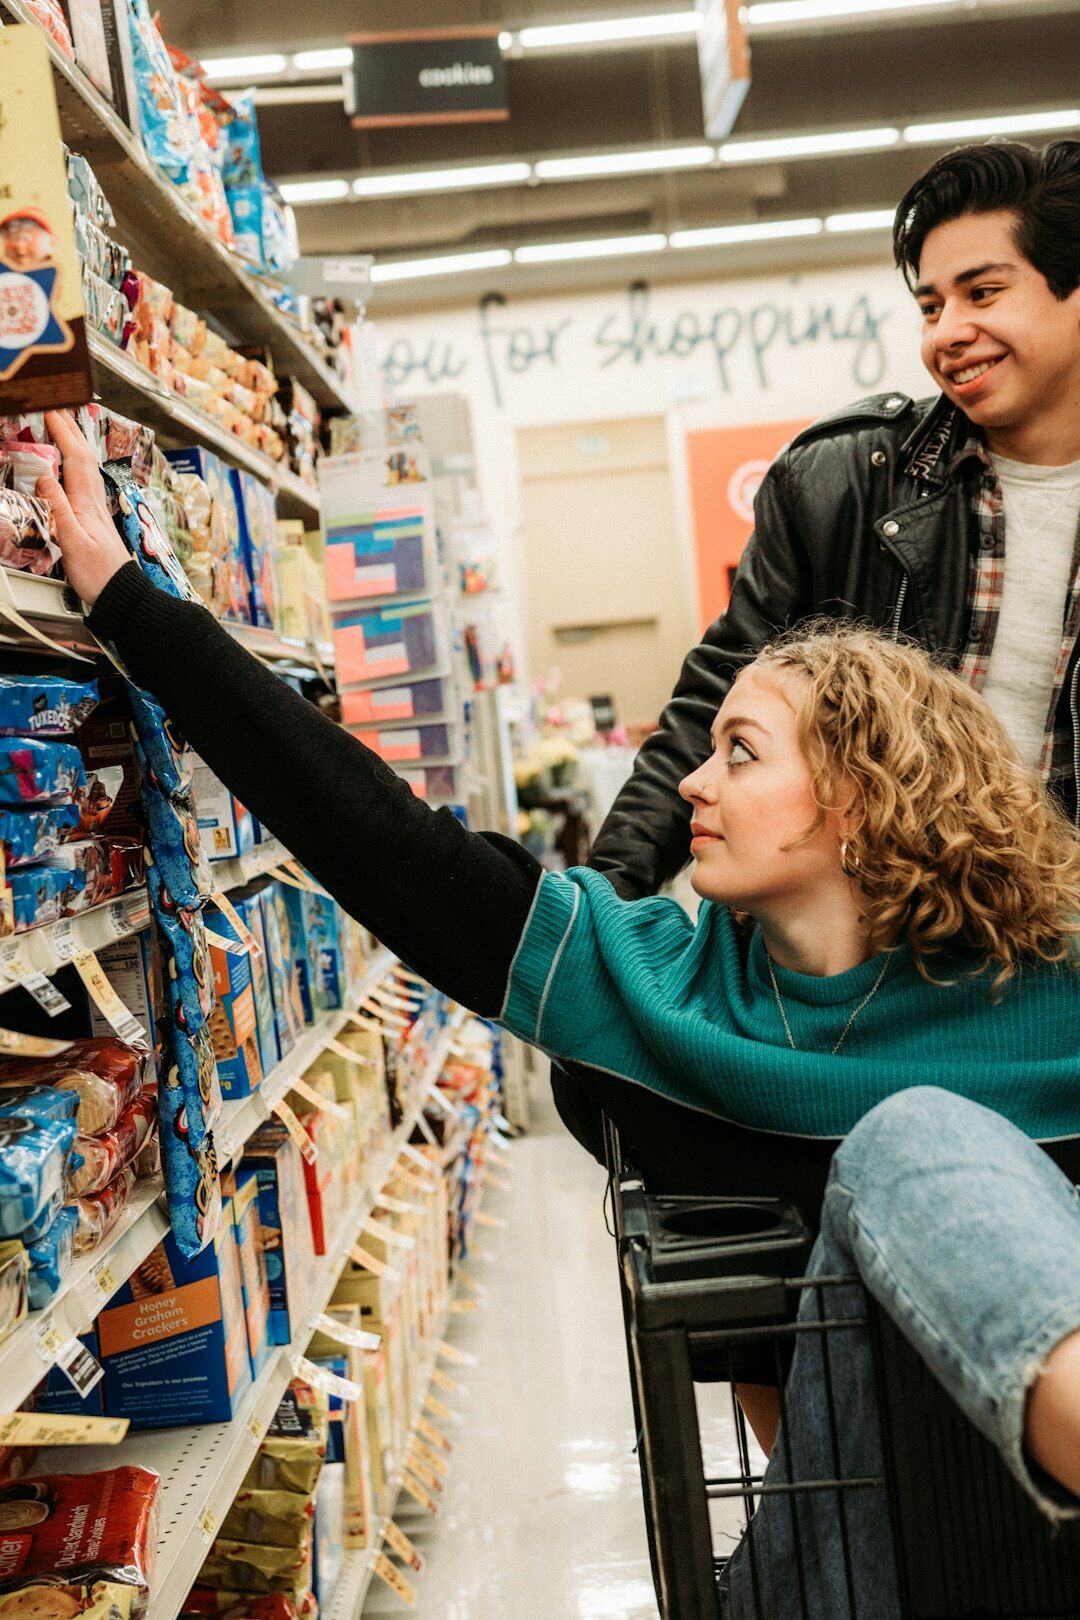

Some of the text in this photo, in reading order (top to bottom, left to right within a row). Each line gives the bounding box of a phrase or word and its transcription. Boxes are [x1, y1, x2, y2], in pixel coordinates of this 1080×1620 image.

[381, 280, 891, 406] ou for shopping
[28, 709, 71, 731] TUXEDOS
[140, 1297, 176, 1314] Honey
[132, 1317, 188, 1340] Crackers
[134, 1307, 184, 1328] Graham
[63, 1504, 90, 1542] Sandwich
